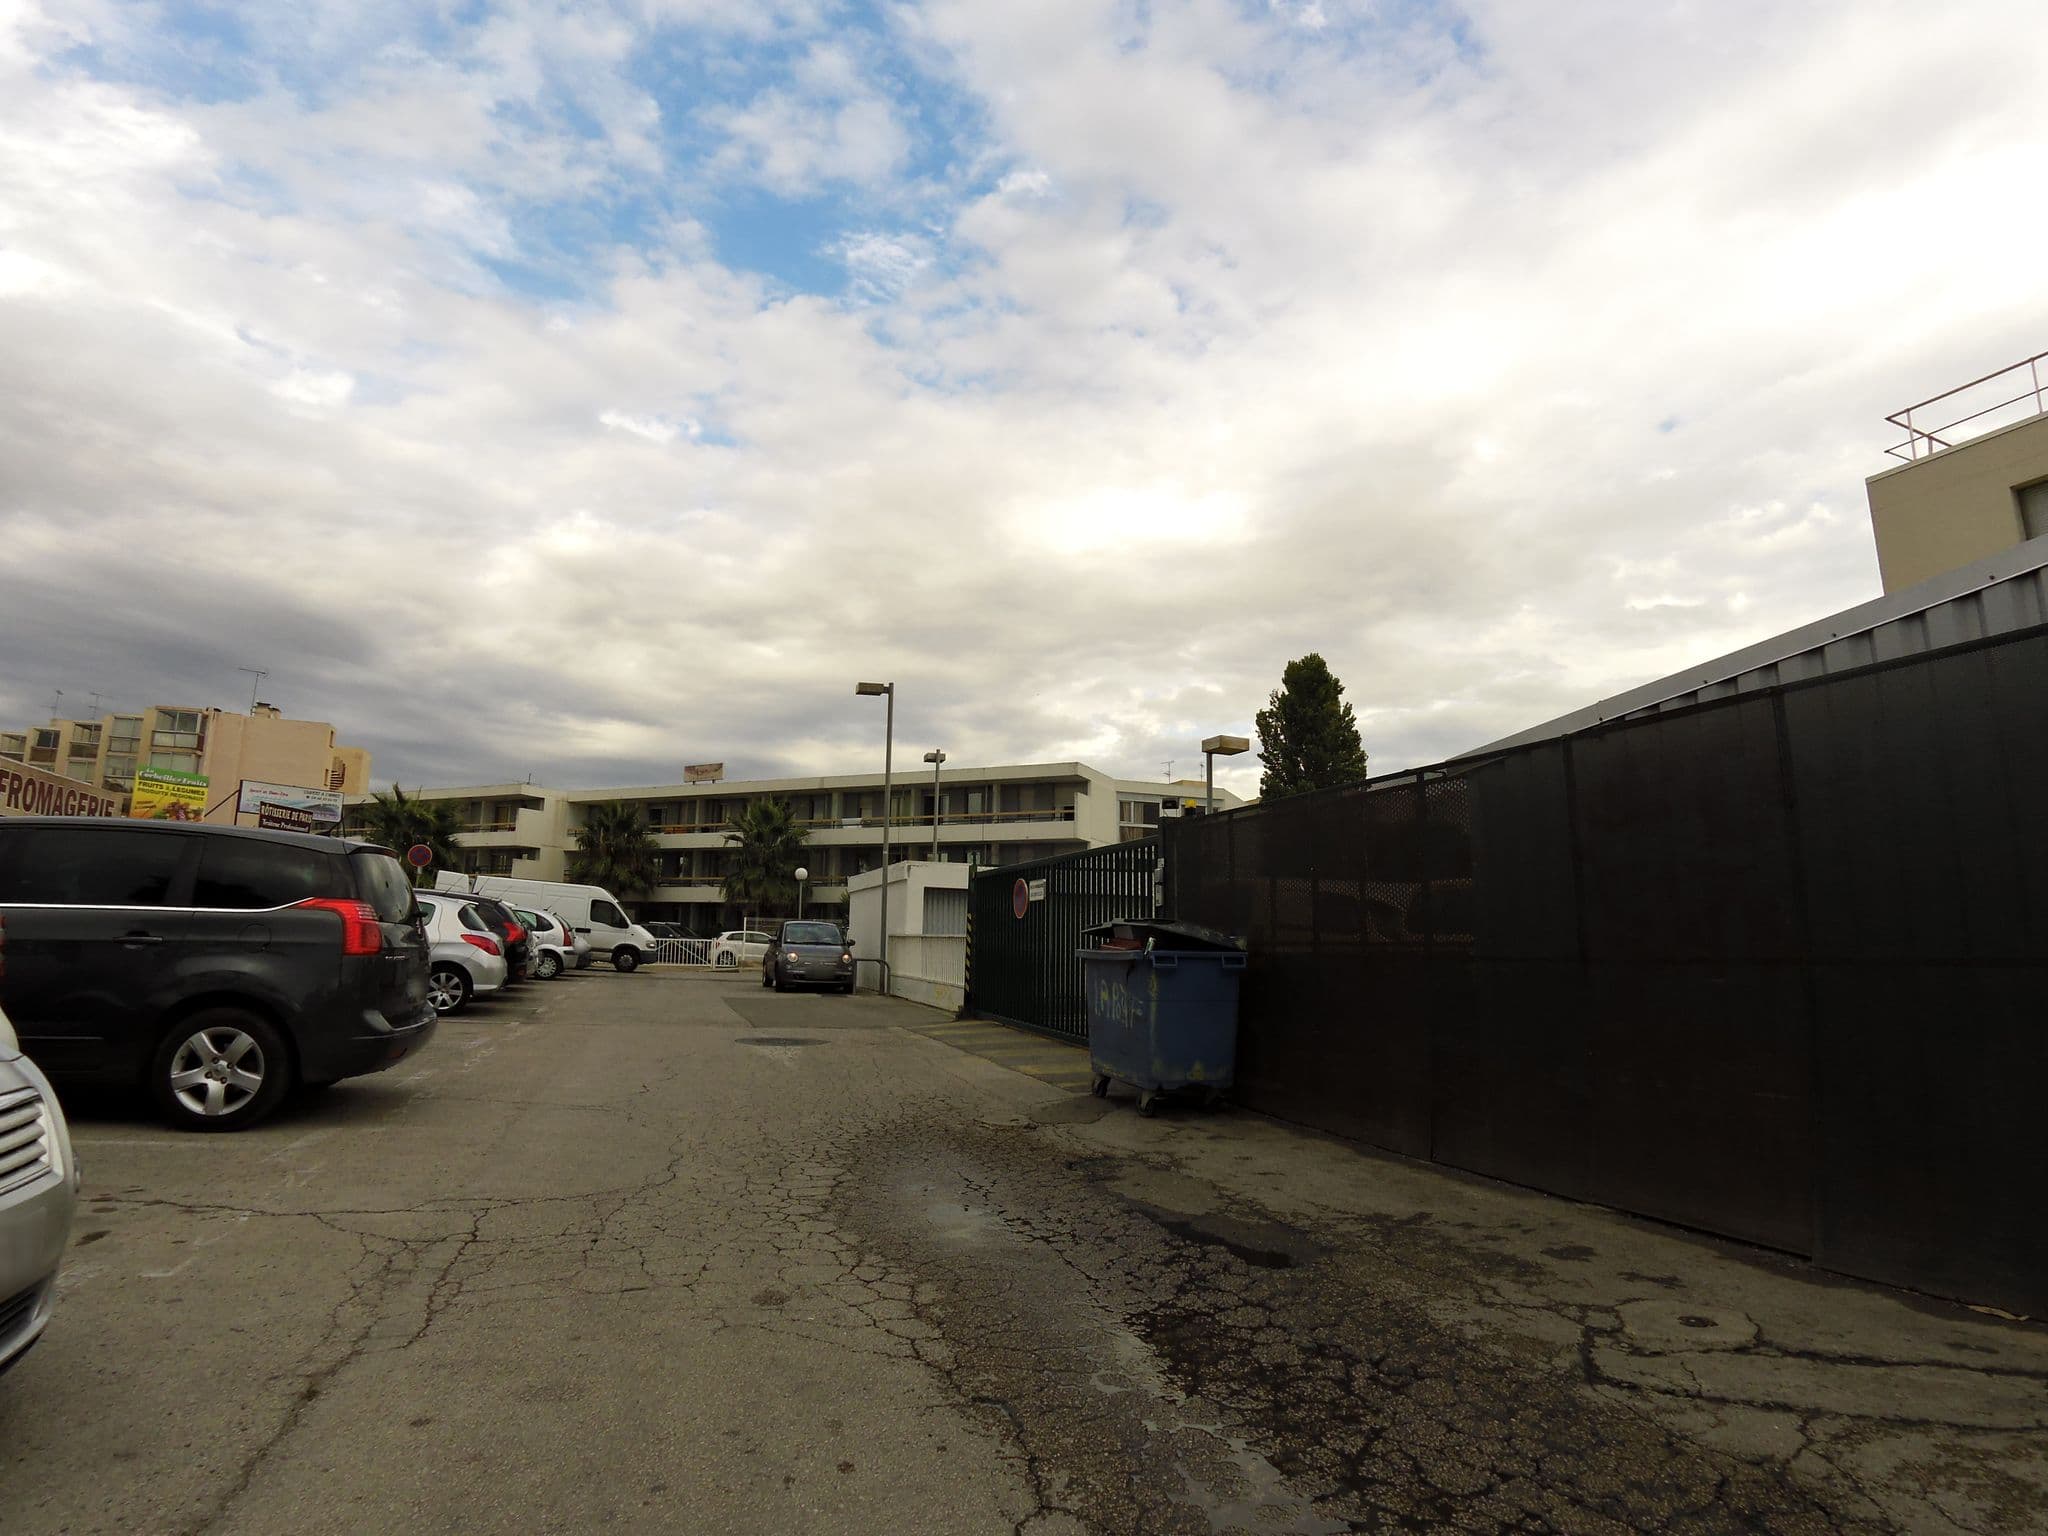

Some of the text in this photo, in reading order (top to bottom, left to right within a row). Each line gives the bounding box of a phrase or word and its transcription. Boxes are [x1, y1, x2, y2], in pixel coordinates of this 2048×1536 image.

[138, 781, 163, 790] FRUITS
[0, 770, 115, 817] FROMAGERIE
[291, 811, 299, 821] DE
[299, 812, 312, 824] PARIS
